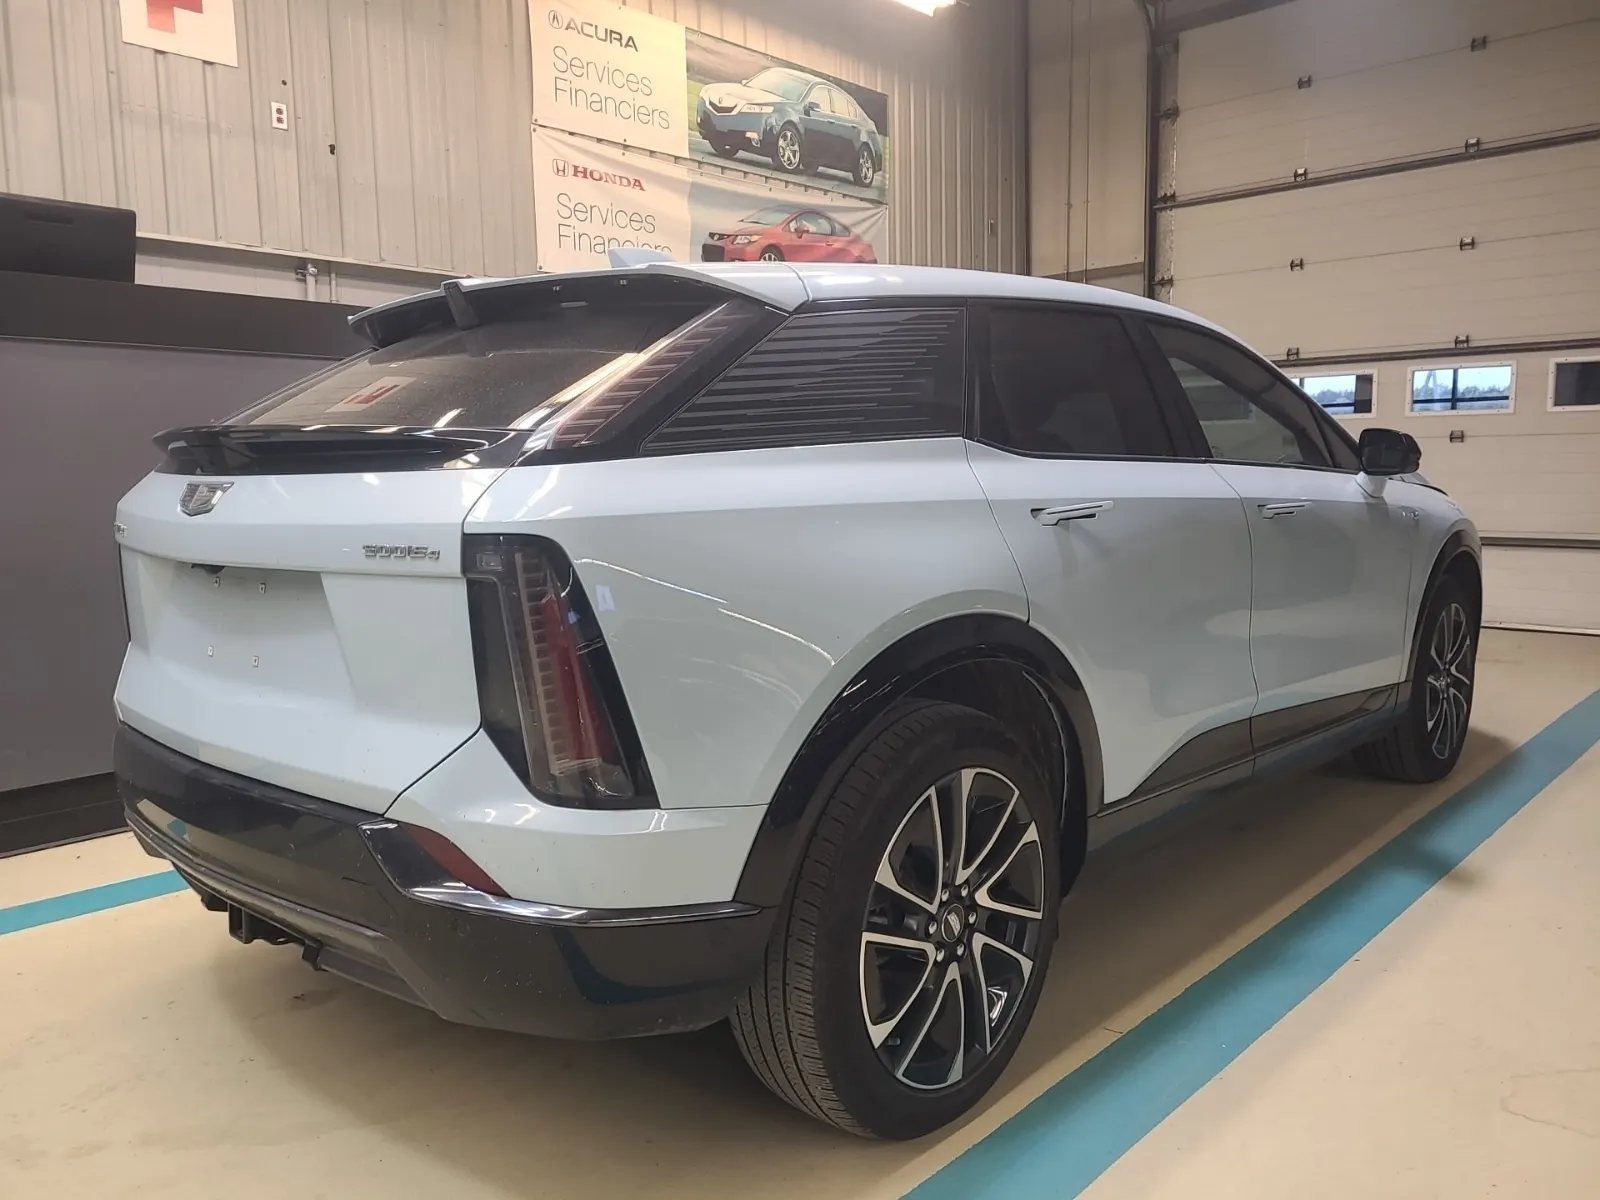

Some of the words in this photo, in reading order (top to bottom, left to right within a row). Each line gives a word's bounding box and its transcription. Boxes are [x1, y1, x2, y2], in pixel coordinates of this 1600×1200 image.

[565, 17, 638, 52] ACURA
[553, 45, 652, 96] Services
[554, 76, 670, 129] Financiers
[572, 164, 646, 192] HONDA
[557, 192, 656, 234] Services
